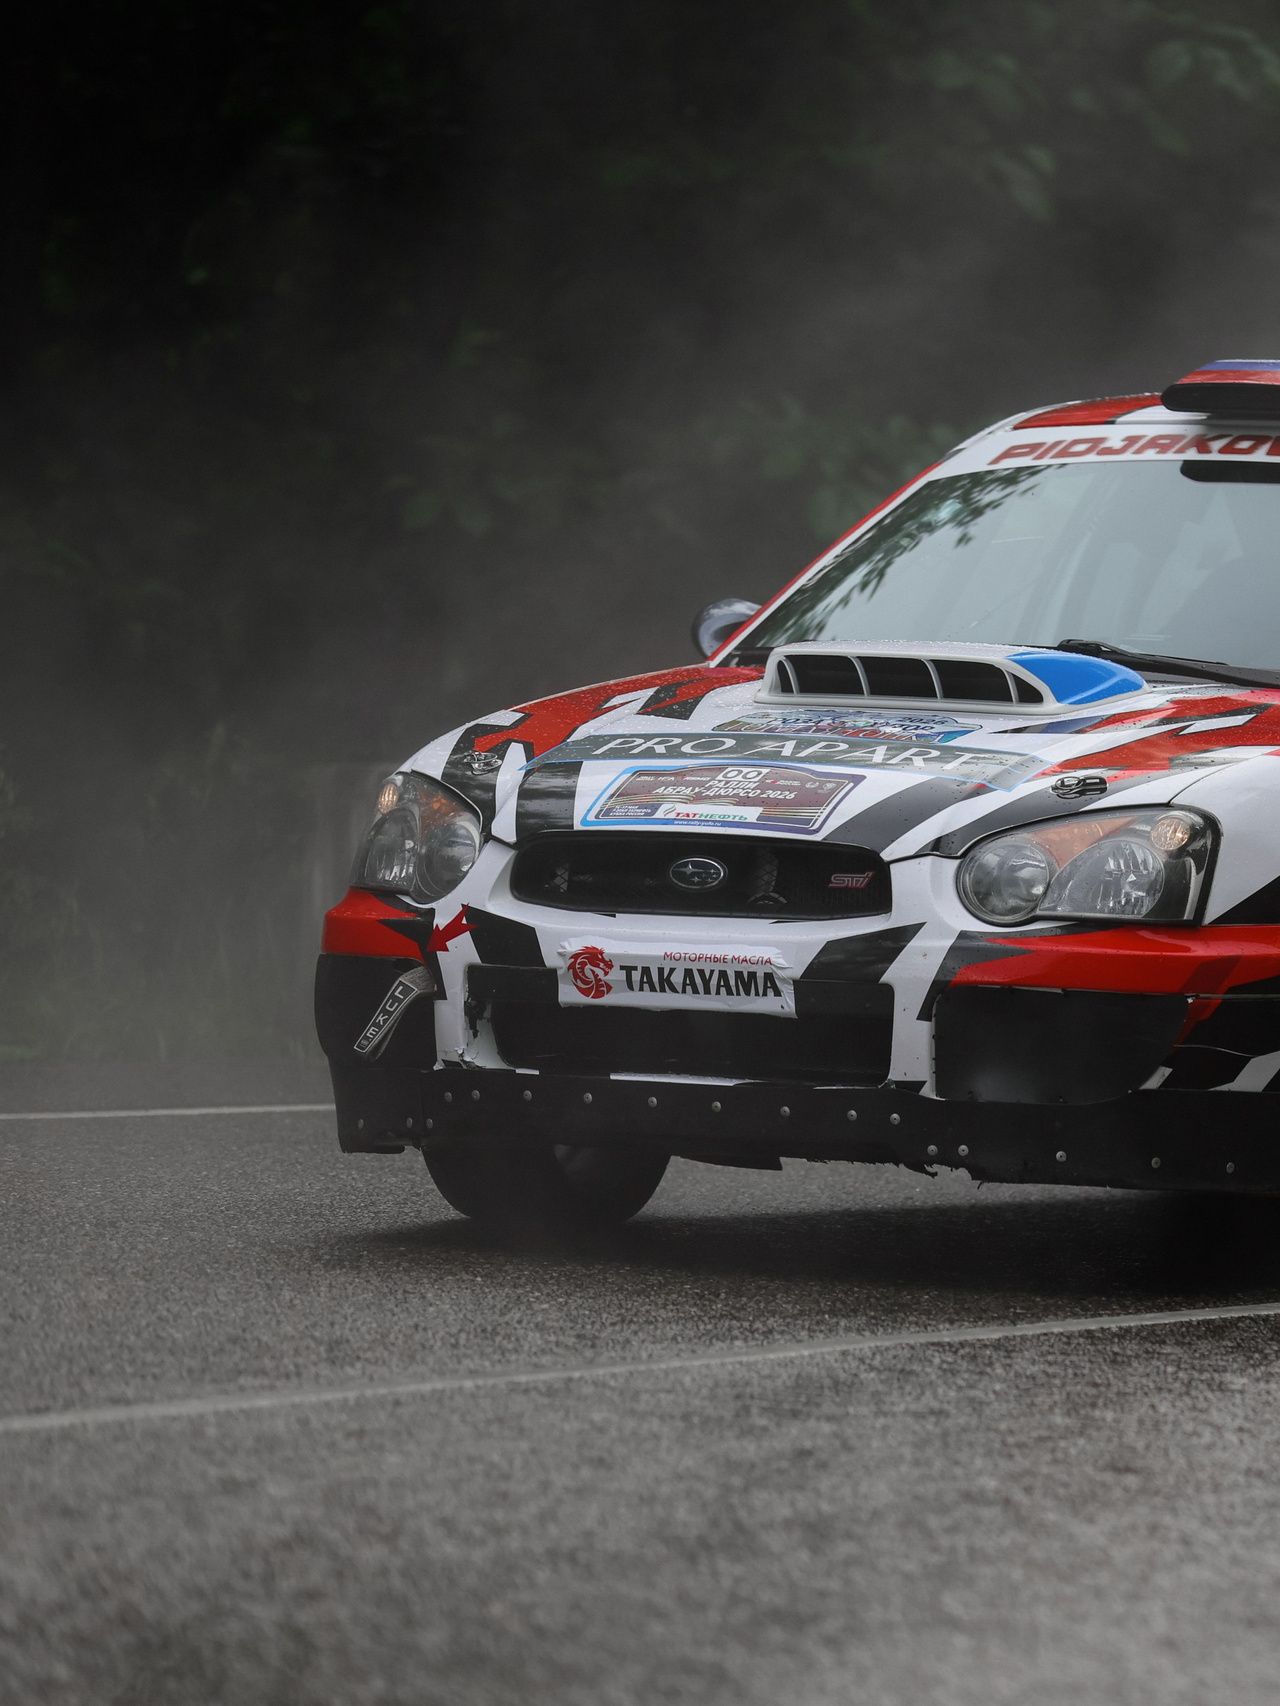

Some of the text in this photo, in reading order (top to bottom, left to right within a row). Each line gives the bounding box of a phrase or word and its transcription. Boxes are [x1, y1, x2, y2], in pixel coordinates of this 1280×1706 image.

[592, 737, 986, 770] PRO APART
[705, 780, 760, 789] РАЛЛИ
[652, 786, 798, 800] АБРАУ-ДЮРСО 2026
[675, 811, 748, 821] ТАТНЕФТЬ
[663, 951, 773, 966] МОТОРНЫЕ МАСЛА
[619, 964, 782, 997] TAKAYAMA
[366, 985, 404, 1038] LUKE
